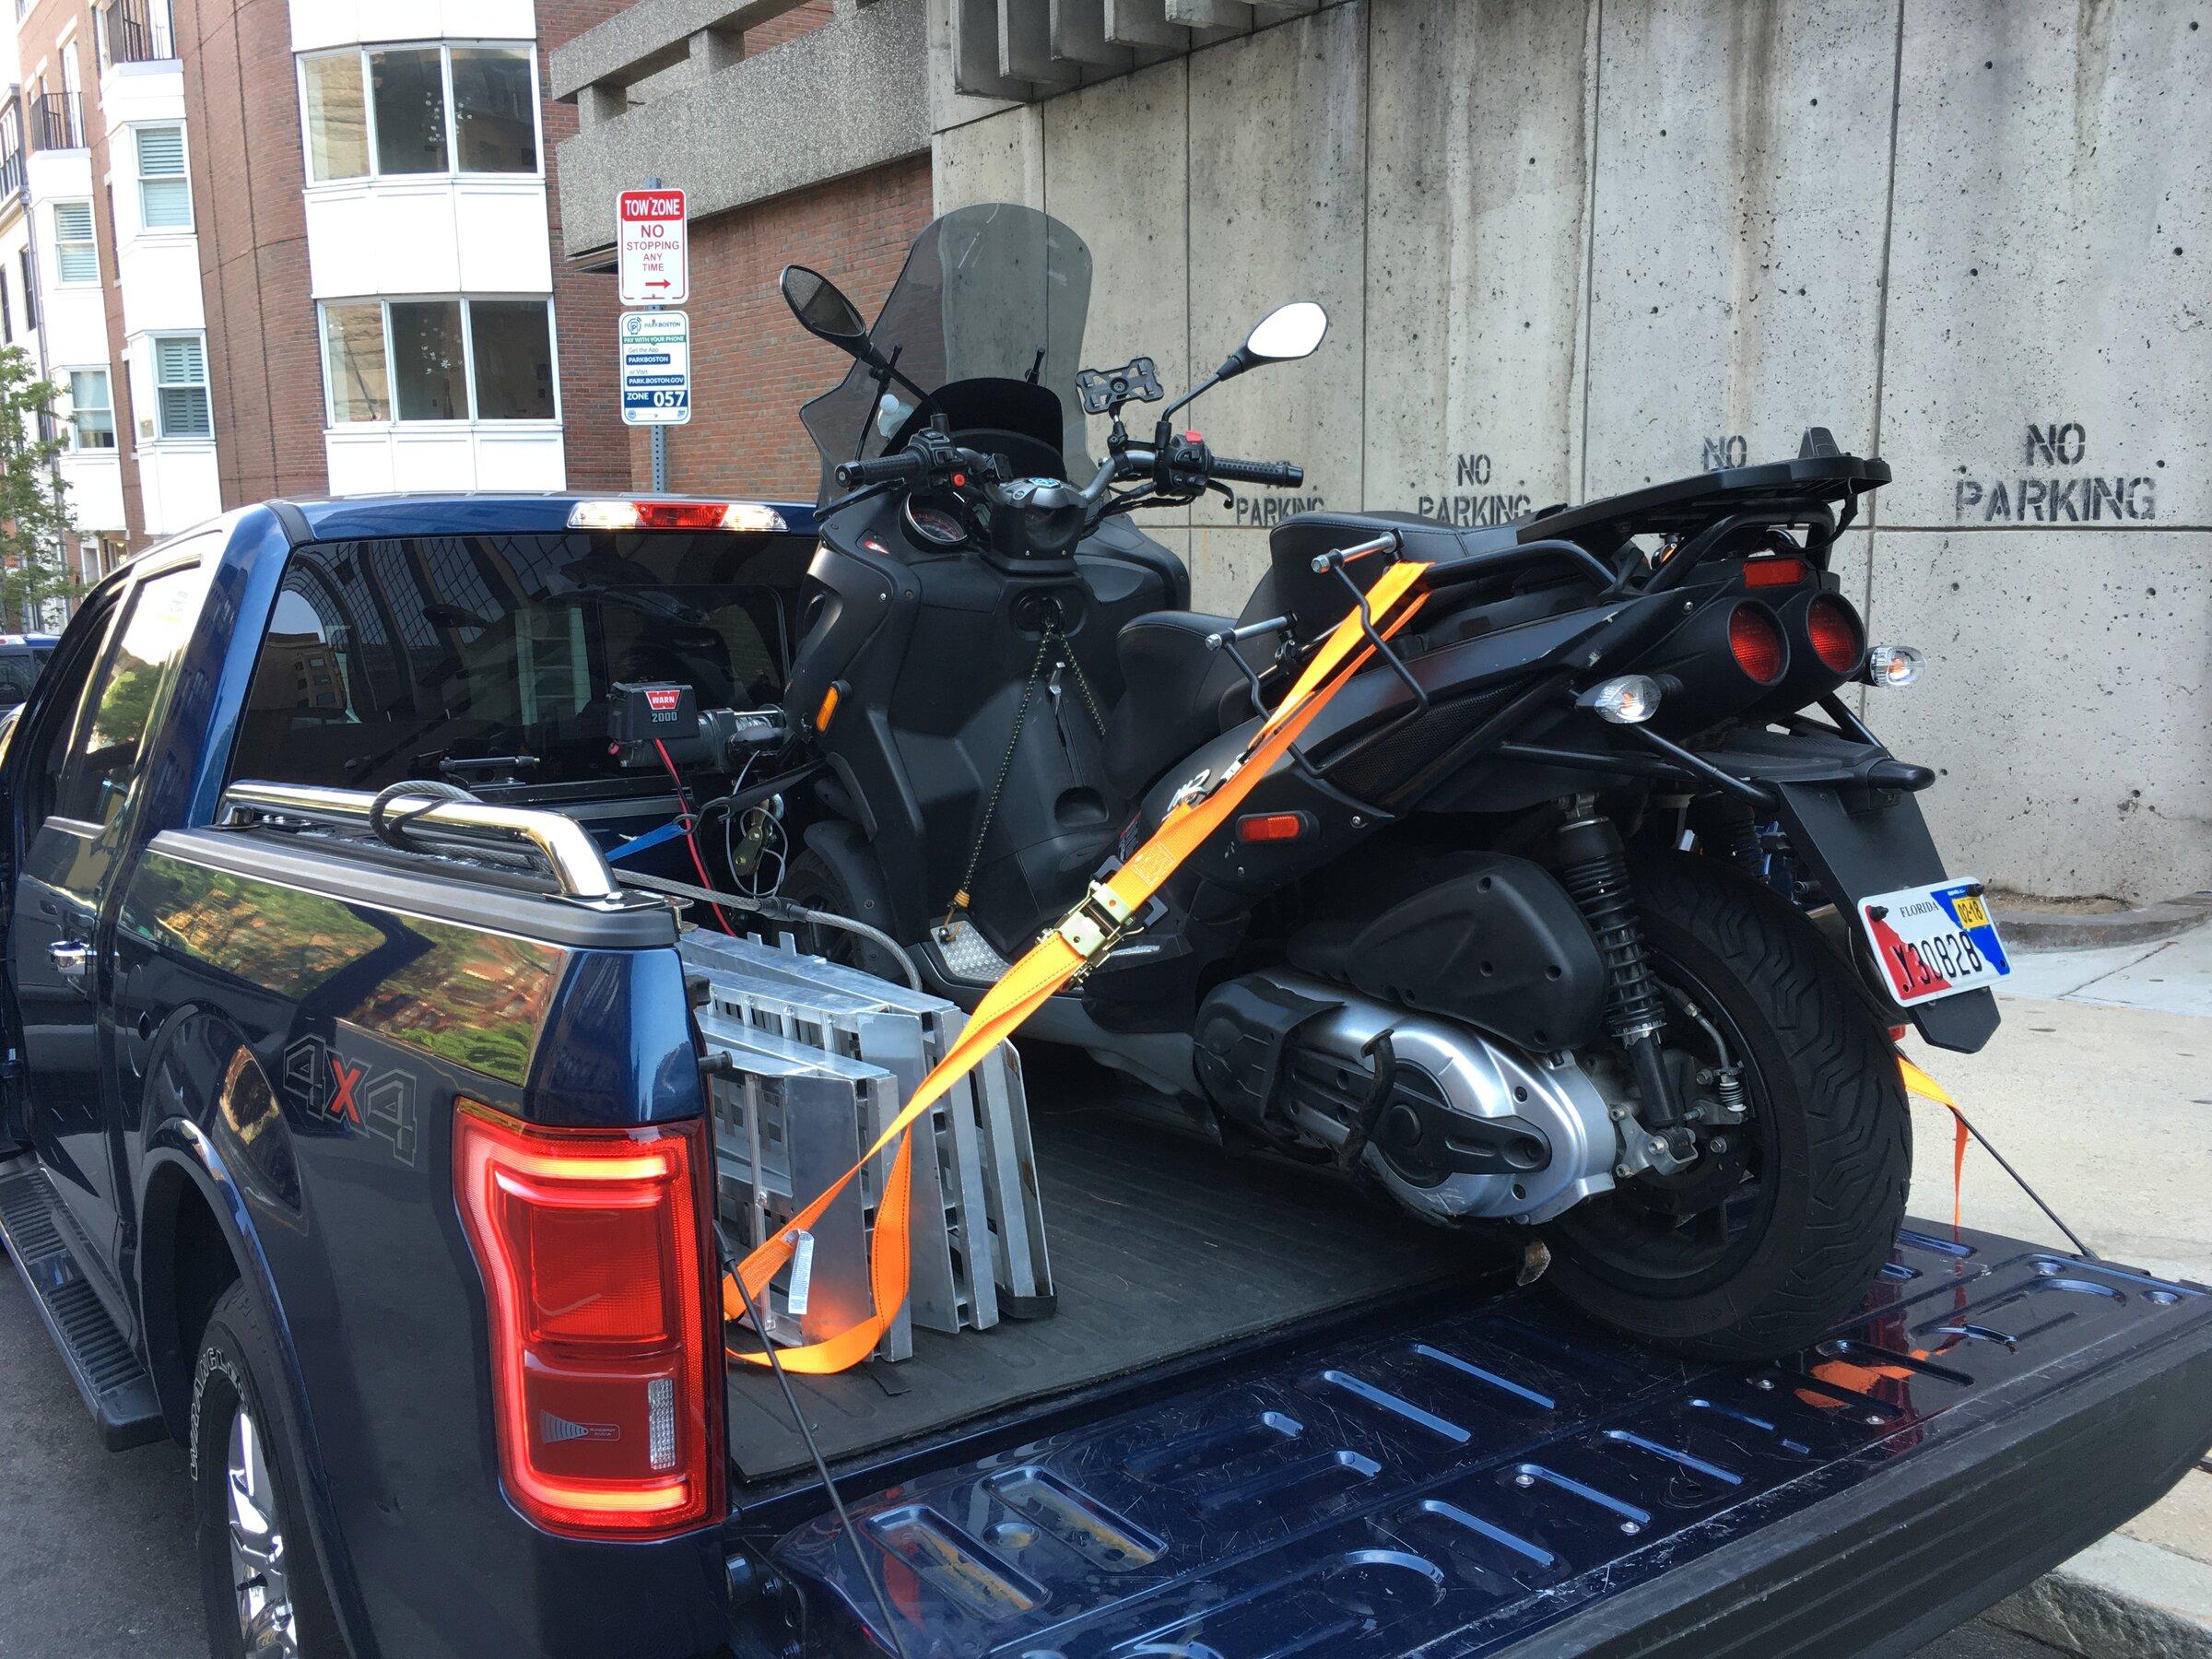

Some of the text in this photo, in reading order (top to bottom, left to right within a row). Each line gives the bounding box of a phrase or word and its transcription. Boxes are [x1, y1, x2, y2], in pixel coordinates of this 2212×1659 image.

[625, 199, 680, 216] TOW ZONE
[641, 225, 664, 238] NO
[627, 241, 679, 251] STOPPING
[653, 391, 685, 407] 057
[2026, 422, 2086, 466] NO
[1702, 435, 1747, 473] NO
[1458, 453, 1491, 486] NO
[1955, 477, 2156, 522] PARKING
[1418, 494, 1532, 527] PARKING
[652, 696, 675, 704] WARN
[652, 712, 677, 723] 2000
[1900, 900, 1939, 918] FLORIDA
[1891, 931, 1983, 988] Y30828
